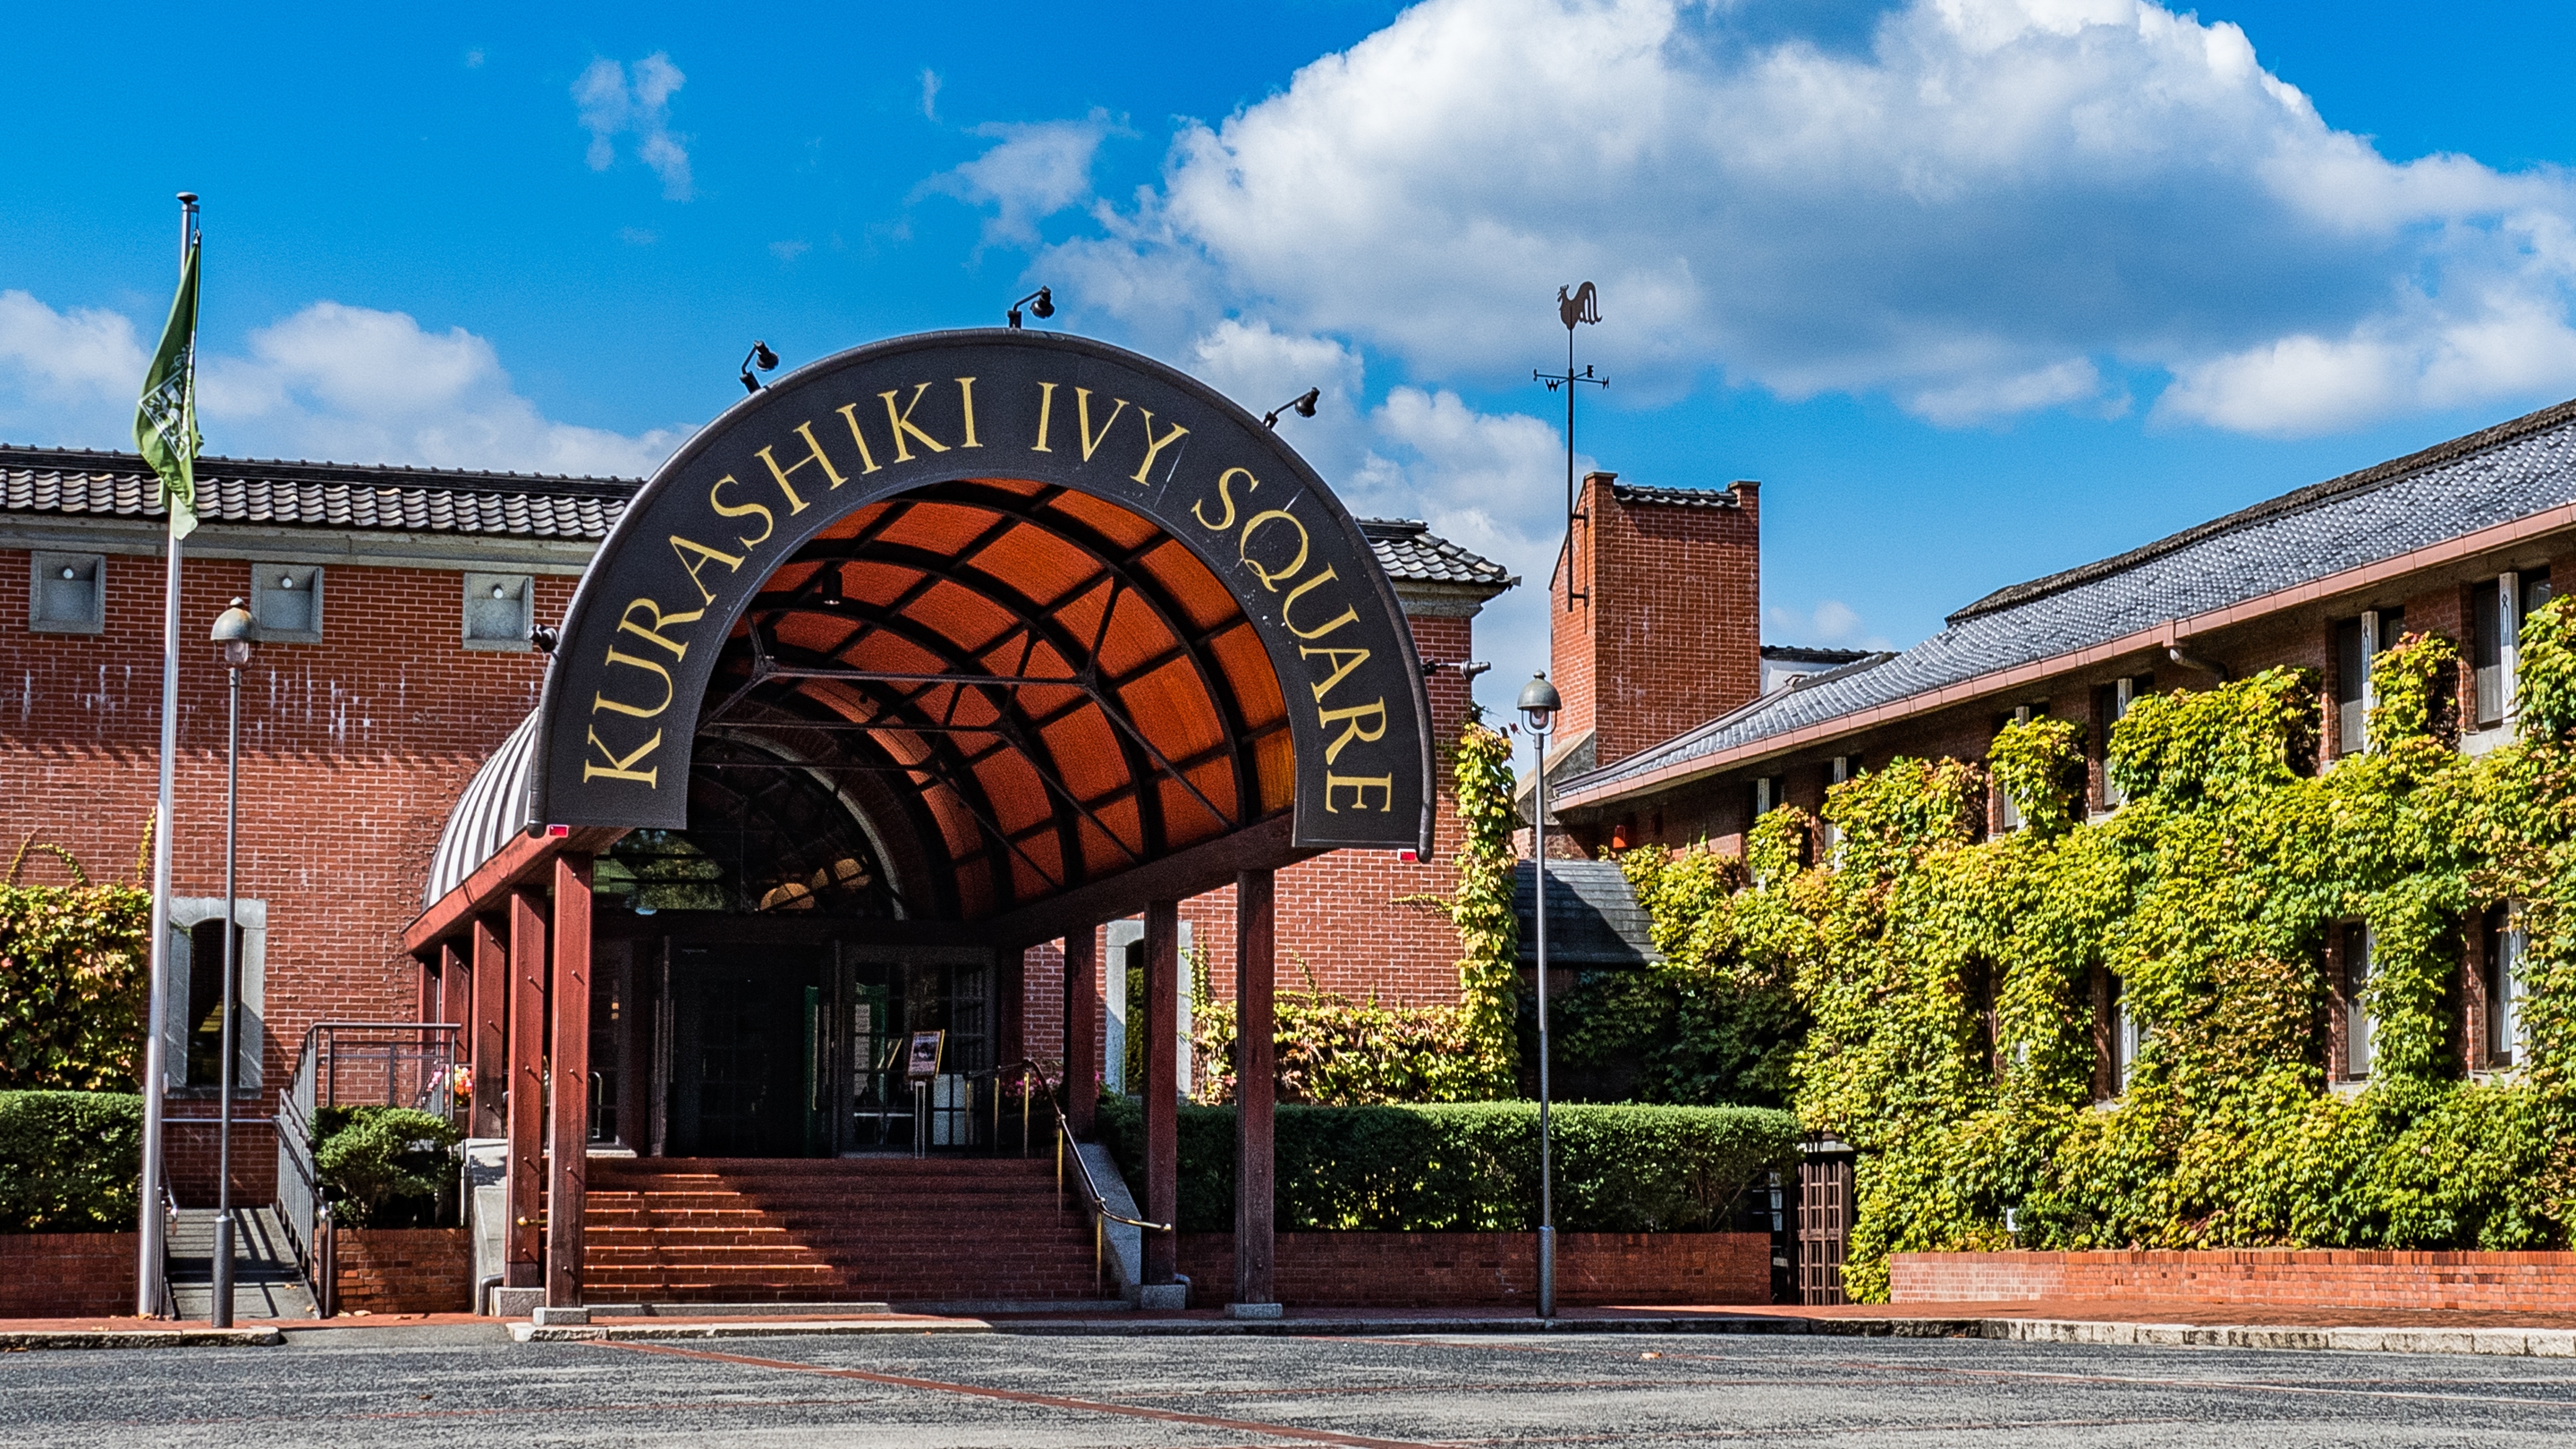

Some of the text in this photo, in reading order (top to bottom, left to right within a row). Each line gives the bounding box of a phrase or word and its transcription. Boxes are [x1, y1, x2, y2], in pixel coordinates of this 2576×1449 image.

[1545, 378, 1560, 392] W
[583, 377, 1393, 813] KURASHIKI IVY SQUARE
